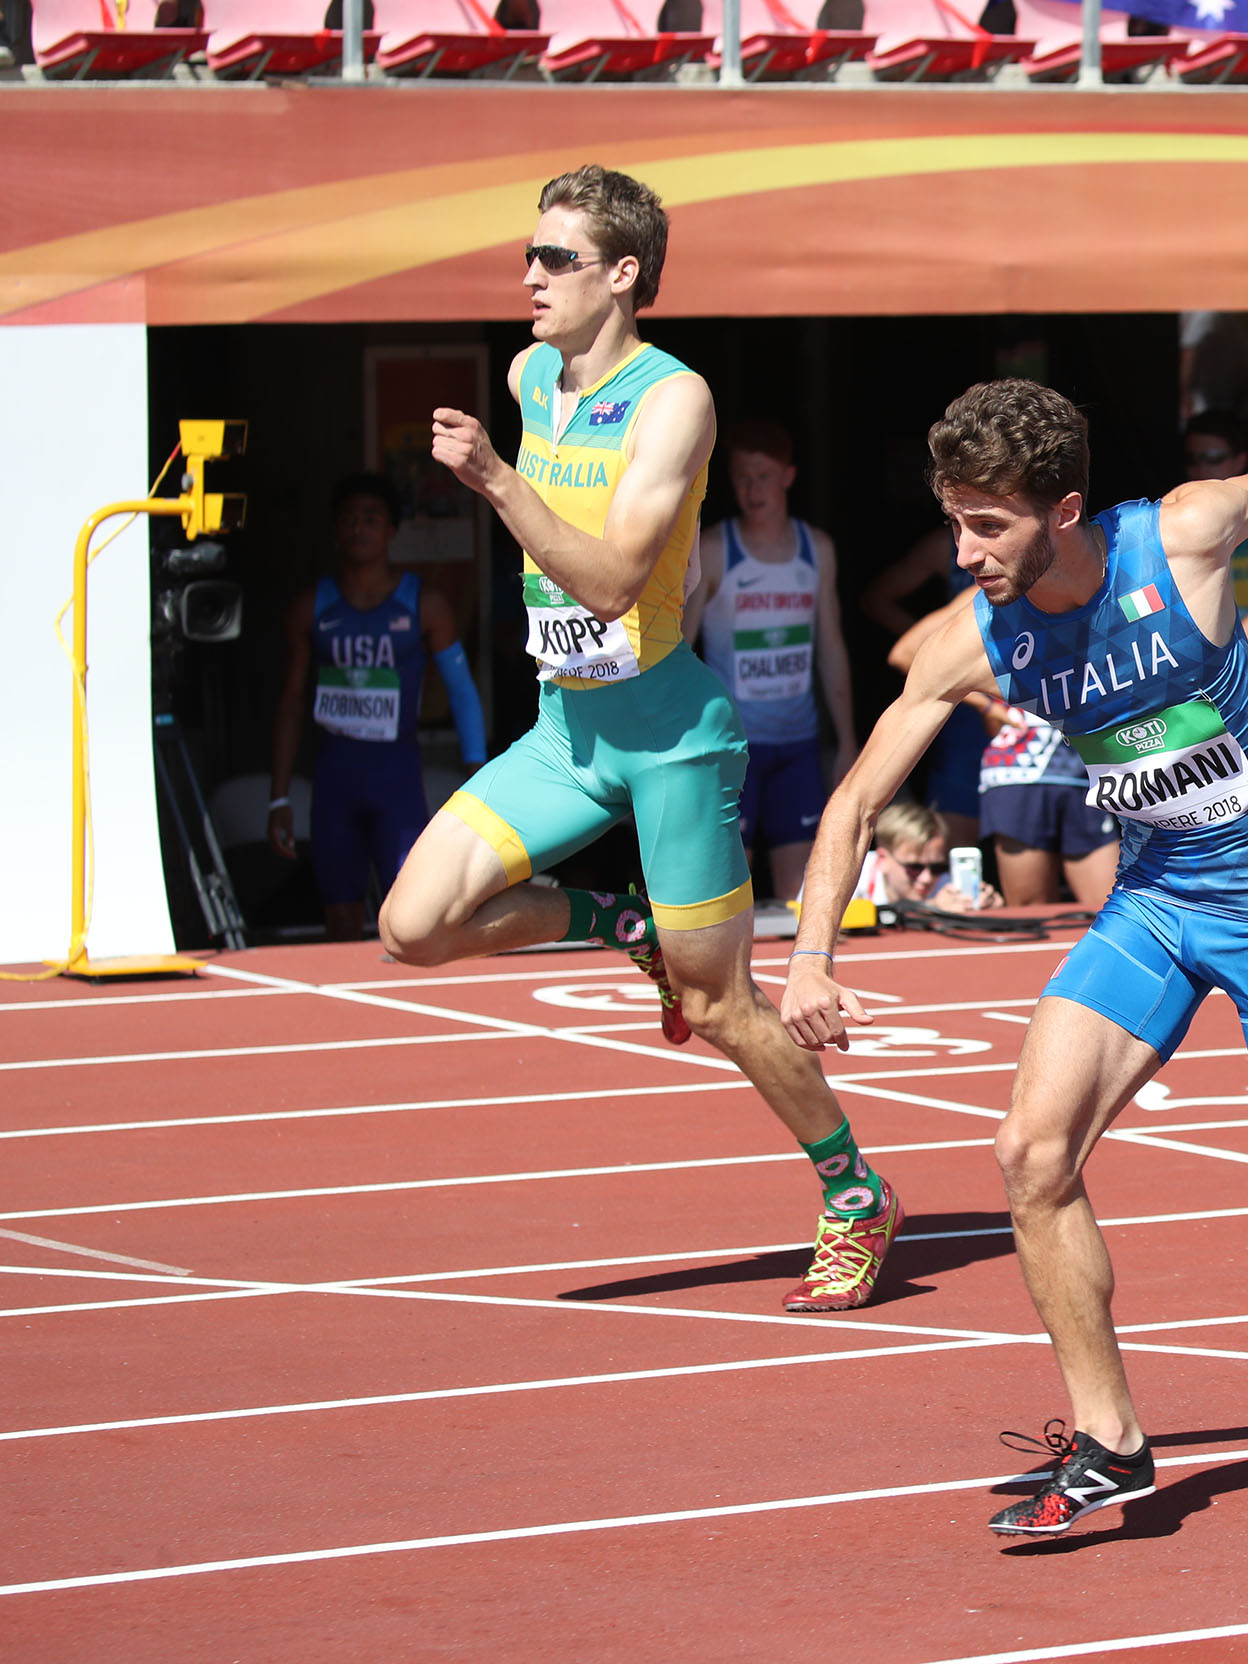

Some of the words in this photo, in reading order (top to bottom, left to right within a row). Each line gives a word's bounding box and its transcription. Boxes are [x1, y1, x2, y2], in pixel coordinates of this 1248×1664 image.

[517, 446, 609, 489] USTRALIA
[331, 633, 395, 669] USA
[538, 616, 608, 655] KOPP
[588, 660, 620, 679] 2018
[738, 651, 808, 682] CHALMERS
[1039, 631, 1180, 715] ITALIA
[317, 691, 395, 719] ROBINSON
[1120, 719, 1163, 745] KOTI
[1135, 739, 1163, 751] PIZZA
[1096, 742, 1240, 812] ROMANI
[1203, 795, 1242, 822] 2018
